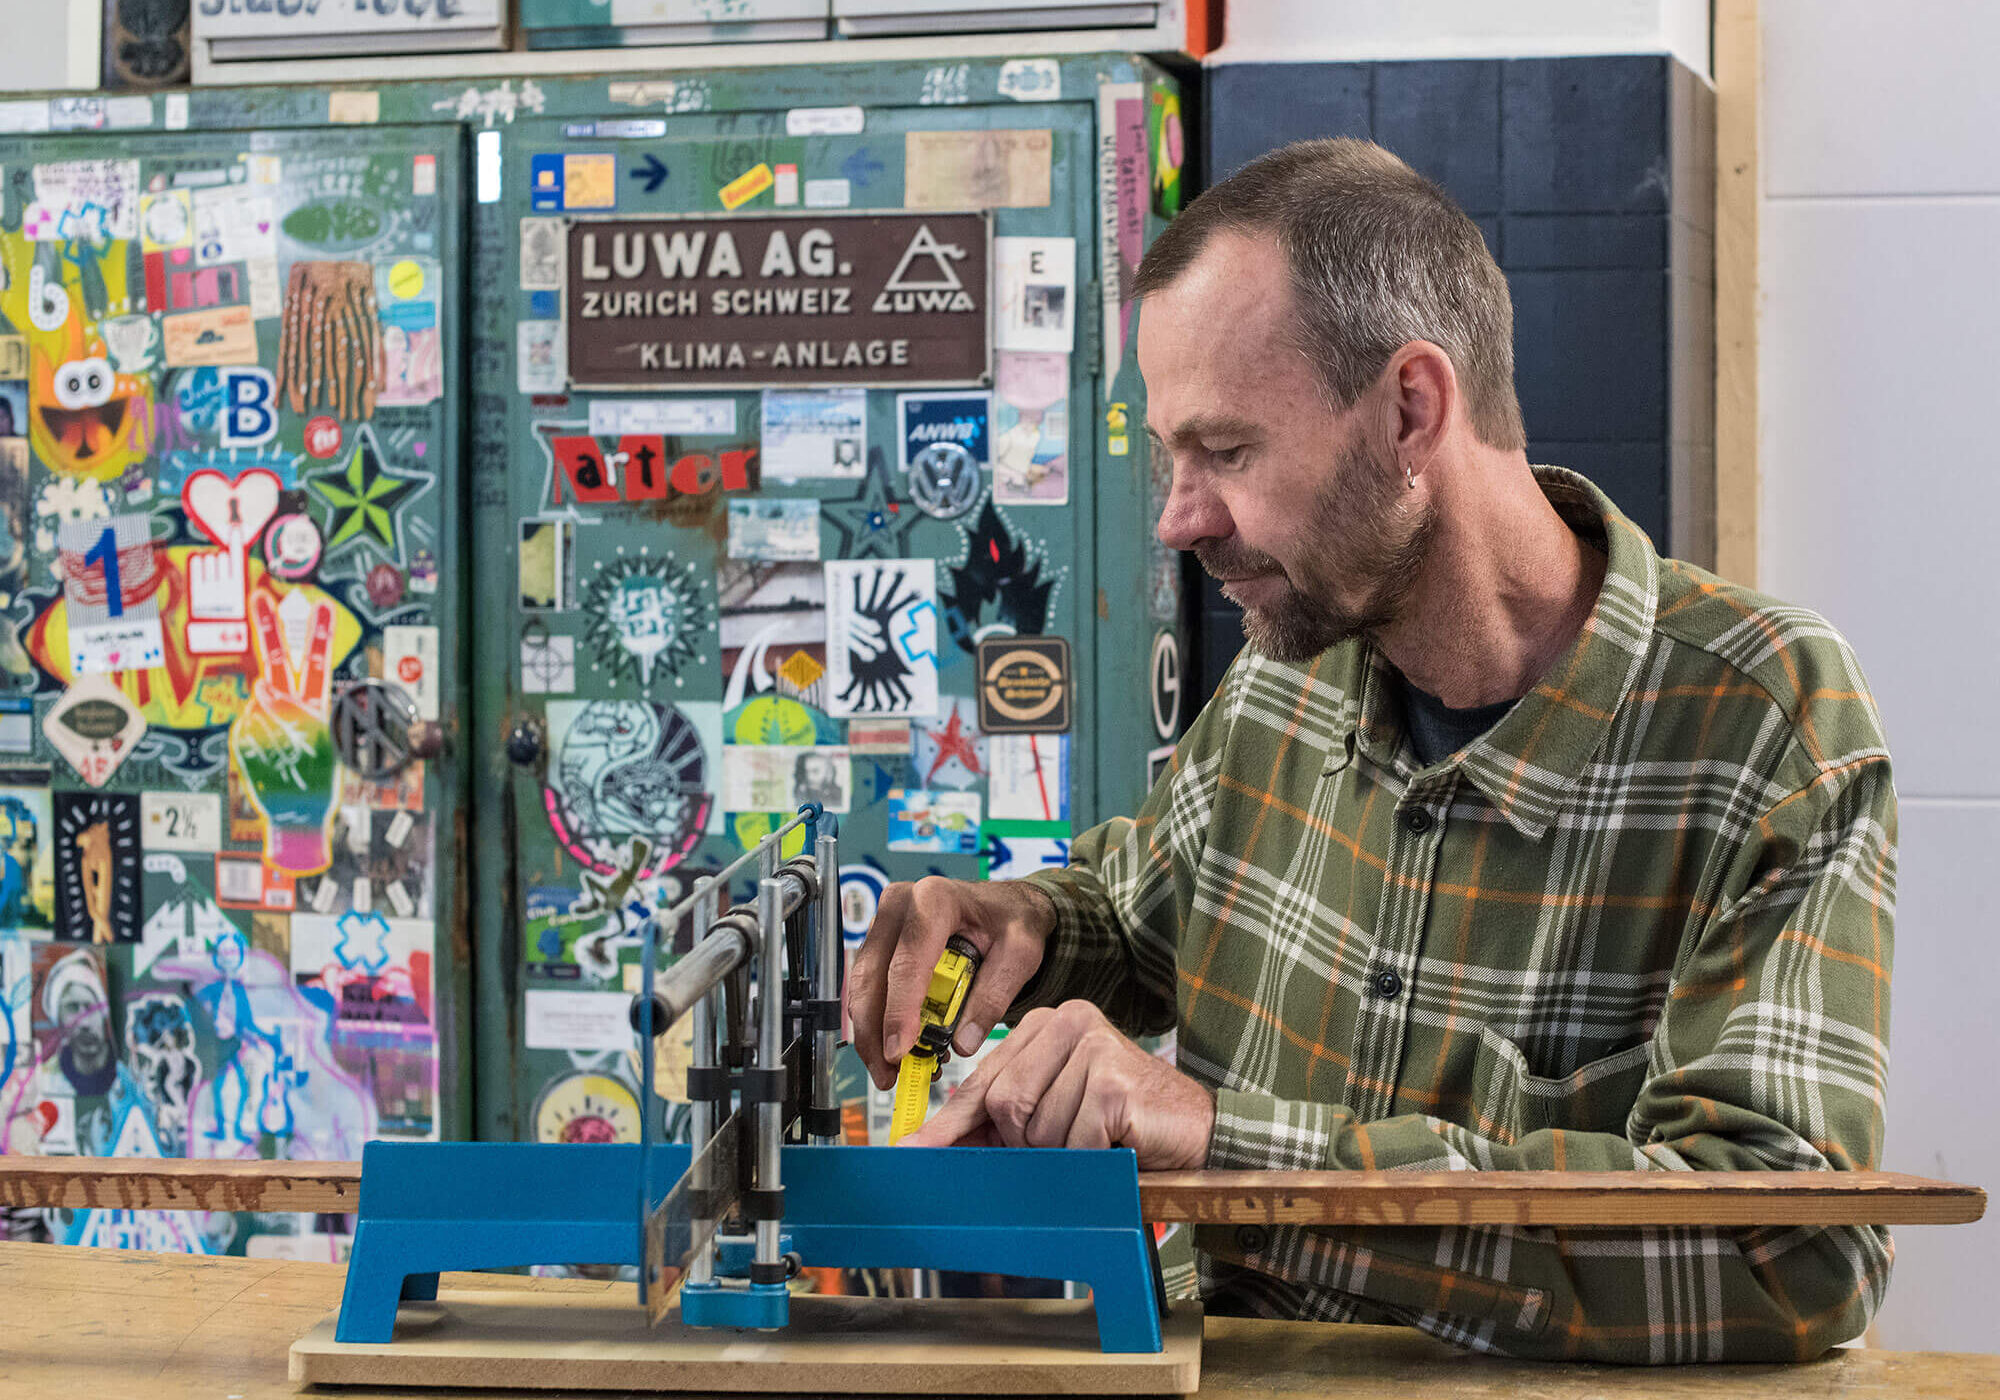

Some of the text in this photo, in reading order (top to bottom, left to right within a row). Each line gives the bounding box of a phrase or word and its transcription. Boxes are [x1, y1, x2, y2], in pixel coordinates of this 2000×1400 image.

[581, 229, 853, 280] LUWA AG.
[1030, 250, 1044, 274] E
[581, 287, 852, 318] ZURICH SCHWEIZ
[225, 371, 275, 442] B
[908, 423, 975, 442] ANWB
